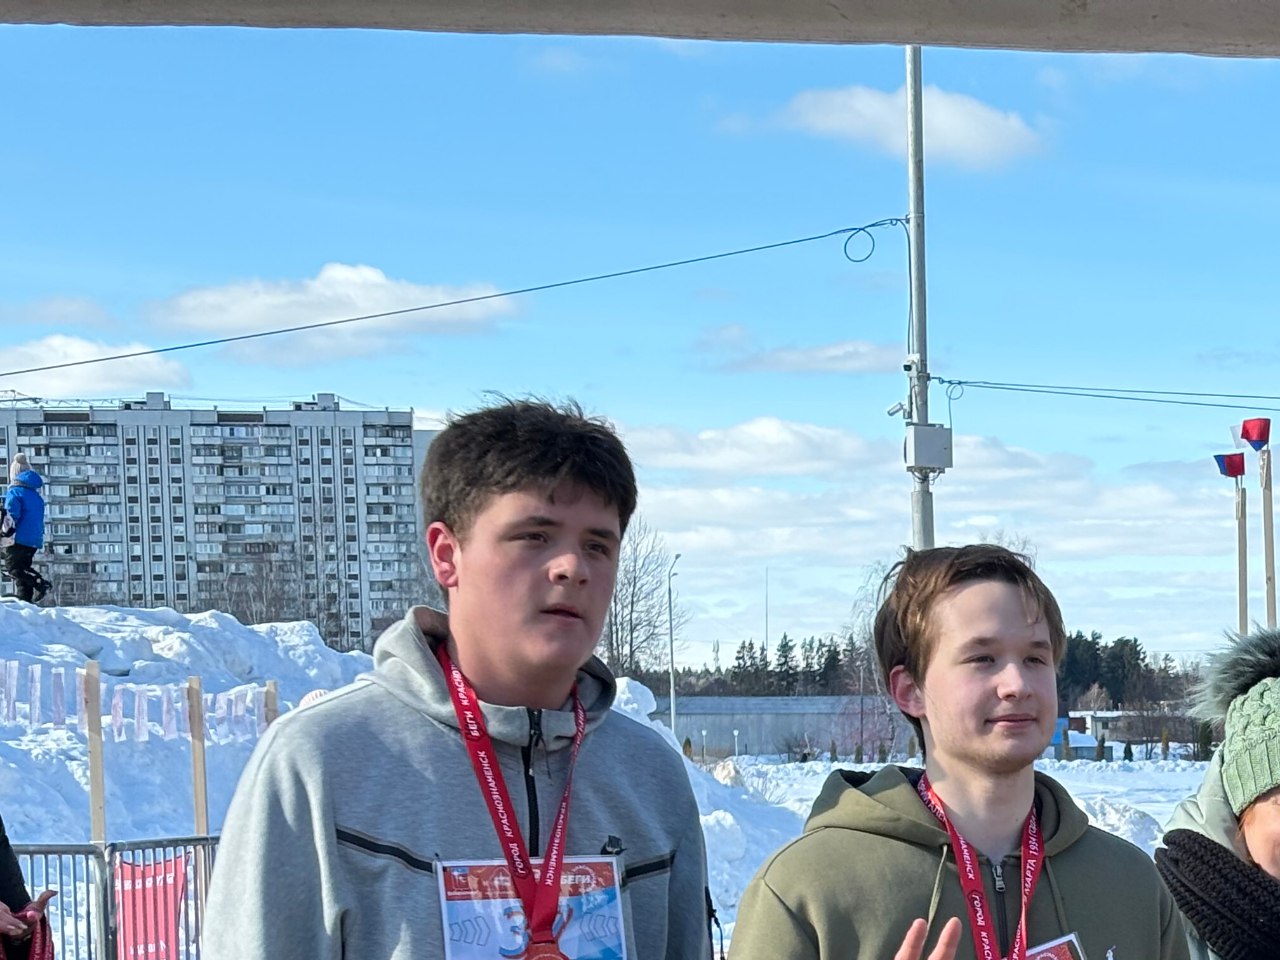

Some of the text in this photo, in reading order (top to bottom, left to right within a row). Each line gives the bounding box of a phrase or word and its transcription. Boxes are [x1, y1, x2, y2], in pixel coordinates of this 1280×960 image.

[464, 711, 480, 737] БЕГИ
[477, 751, 525, 874] ГОРОД КРАСНОЗНАМЕНСК
[972, 894, 986, 926] ГОРОД
